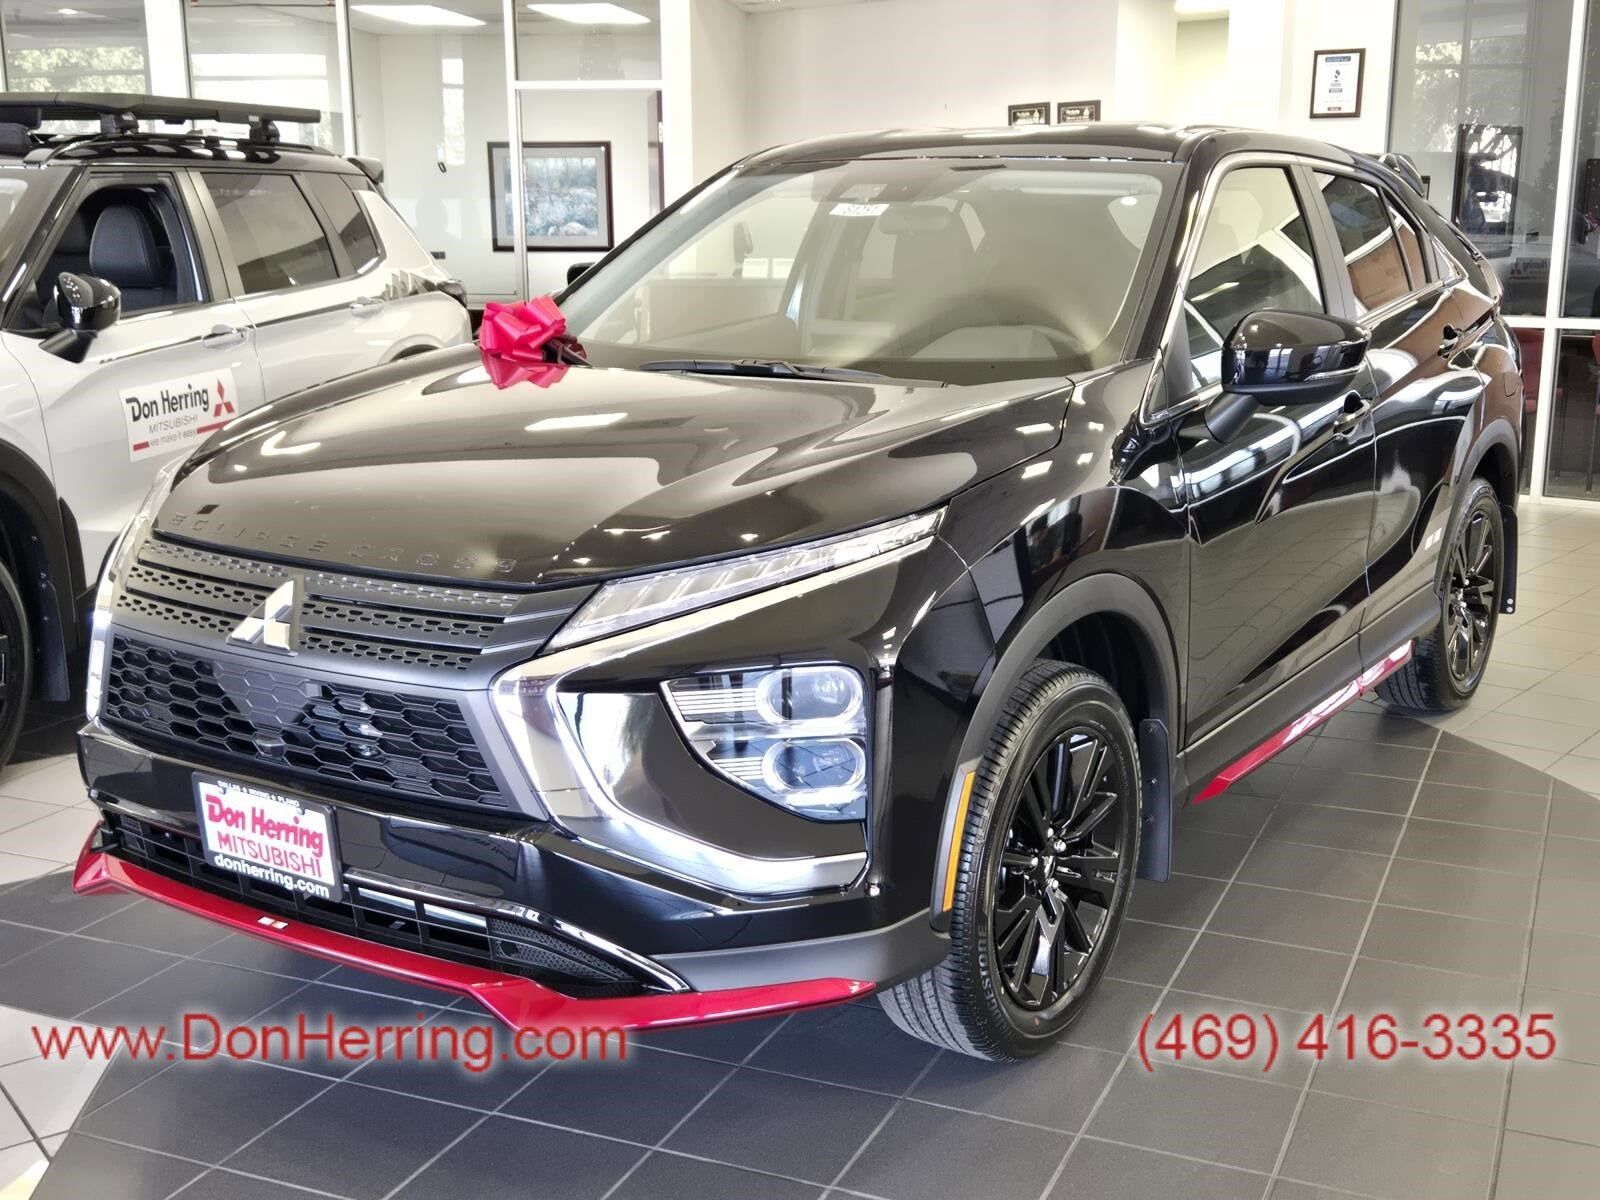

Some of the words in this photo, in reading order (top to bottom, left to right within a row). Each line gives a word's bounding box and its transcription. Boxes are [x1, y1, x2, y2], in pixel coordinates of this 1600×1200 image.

[125, 396, 159, 422] Don
[160, 383, 210, 412] Herring
[149, 415, 199, 434] MITSUBISHI
[168, 512, 329, 552] ECLIPSE
[348, 545, 517, 573] CROSS
[206, 794, 246, 831] Don
[251, 806, 324, 858] Herring
[213, 853, 330, 899] donherring.com
[217, 831, 322, 878] MITSUBISHI
